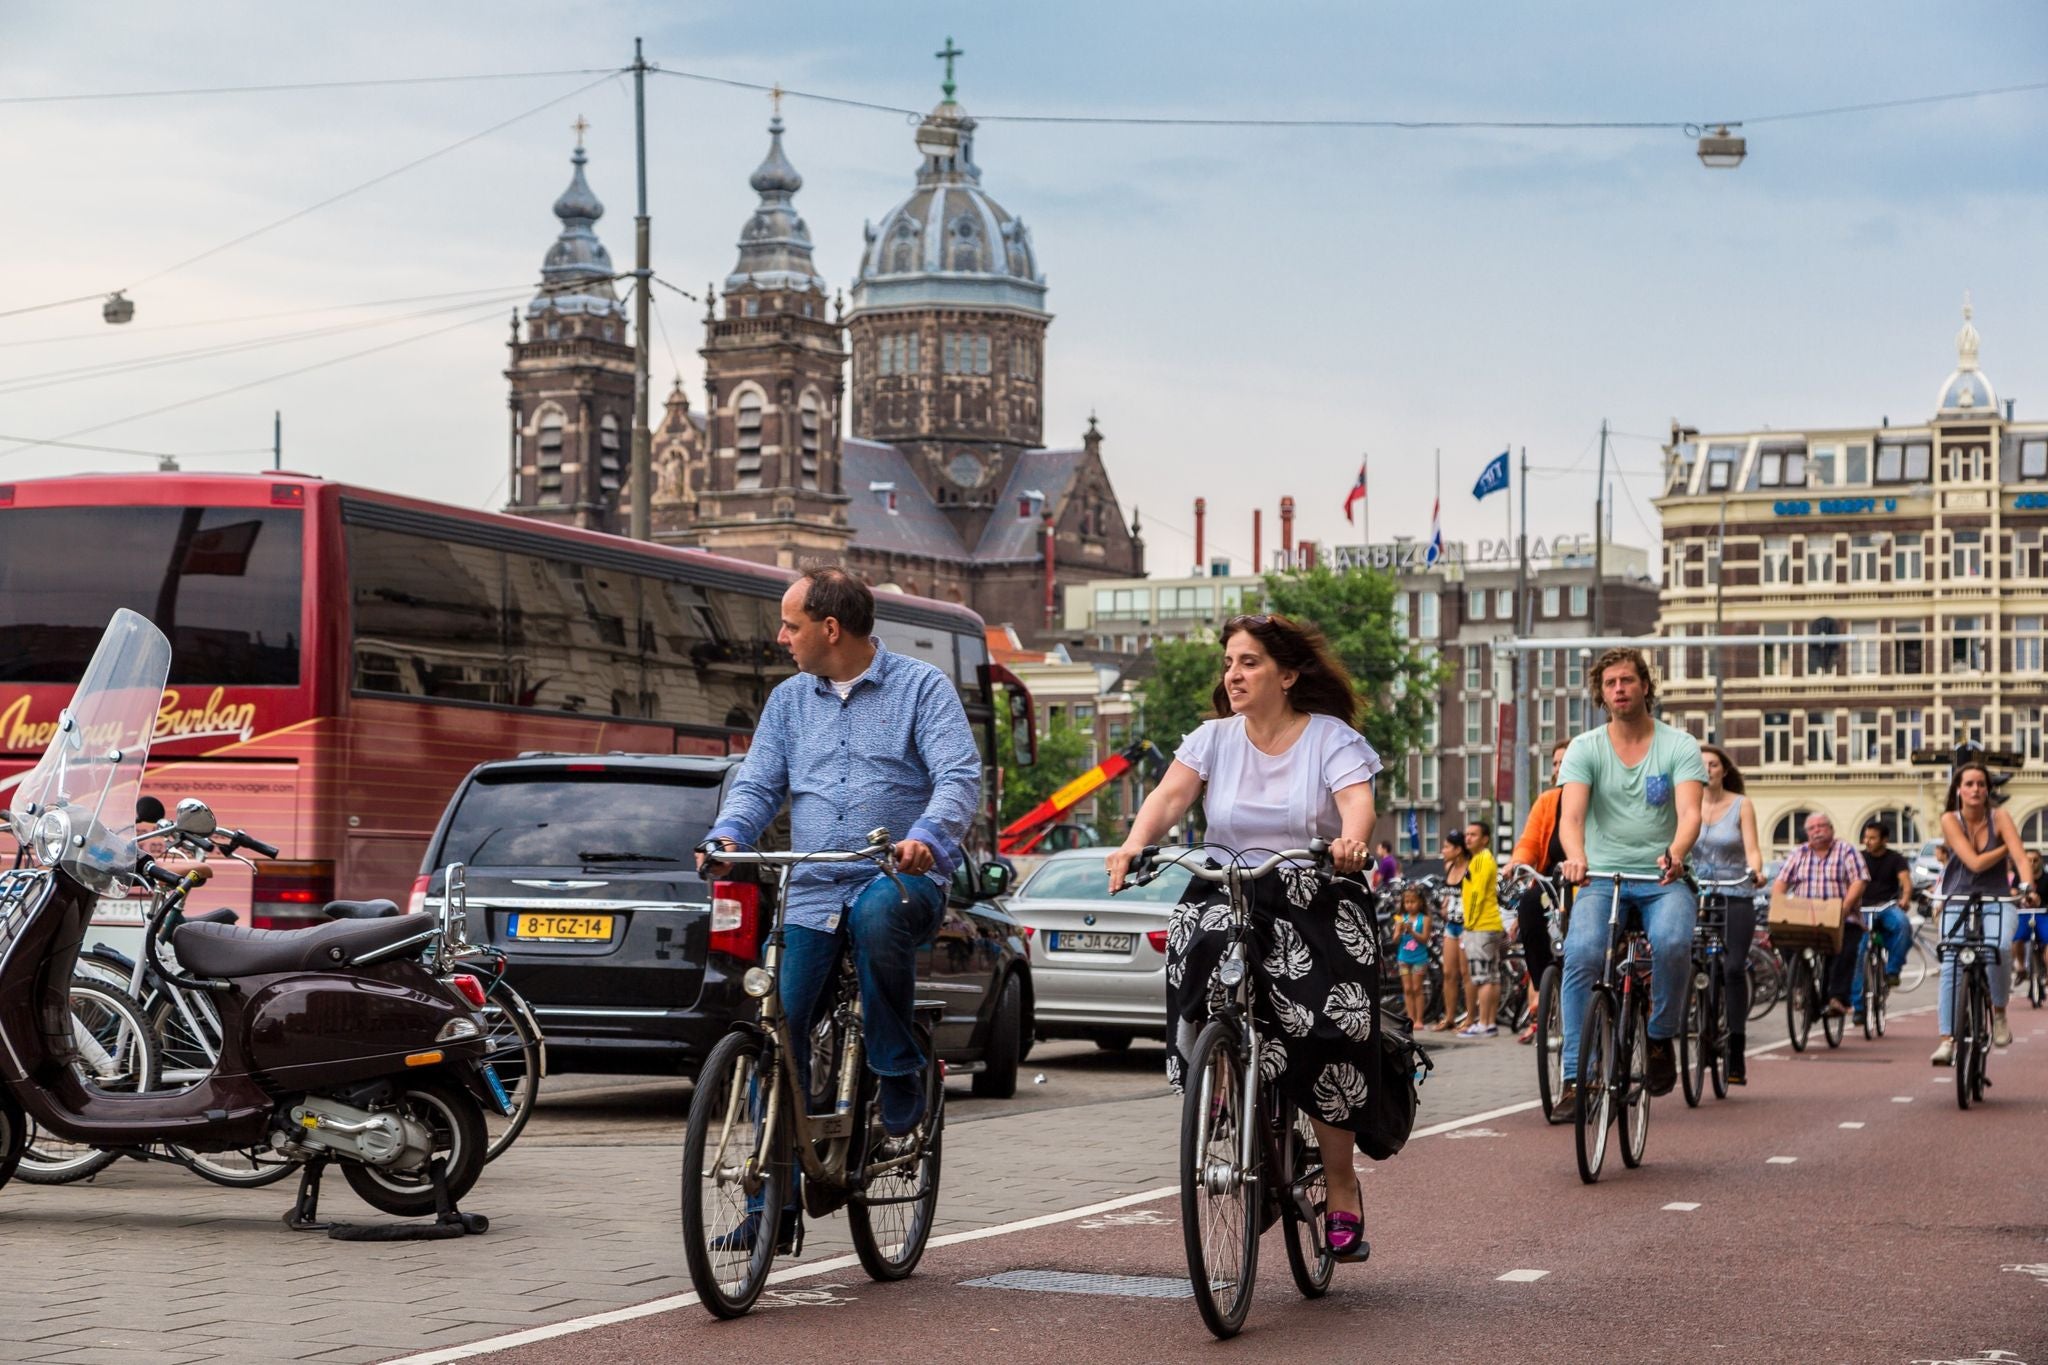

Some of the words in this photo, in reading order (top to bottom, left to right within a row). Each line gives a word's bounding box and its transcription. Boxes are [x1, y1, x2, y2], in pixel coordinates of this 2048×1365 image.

[528, 917, 602, 935] 8-TGZ-14
[1060, 934, 1076, 948] RE
[1084, 934, 1101, 949] JA
[1104, 935, 1129, 950] 422
